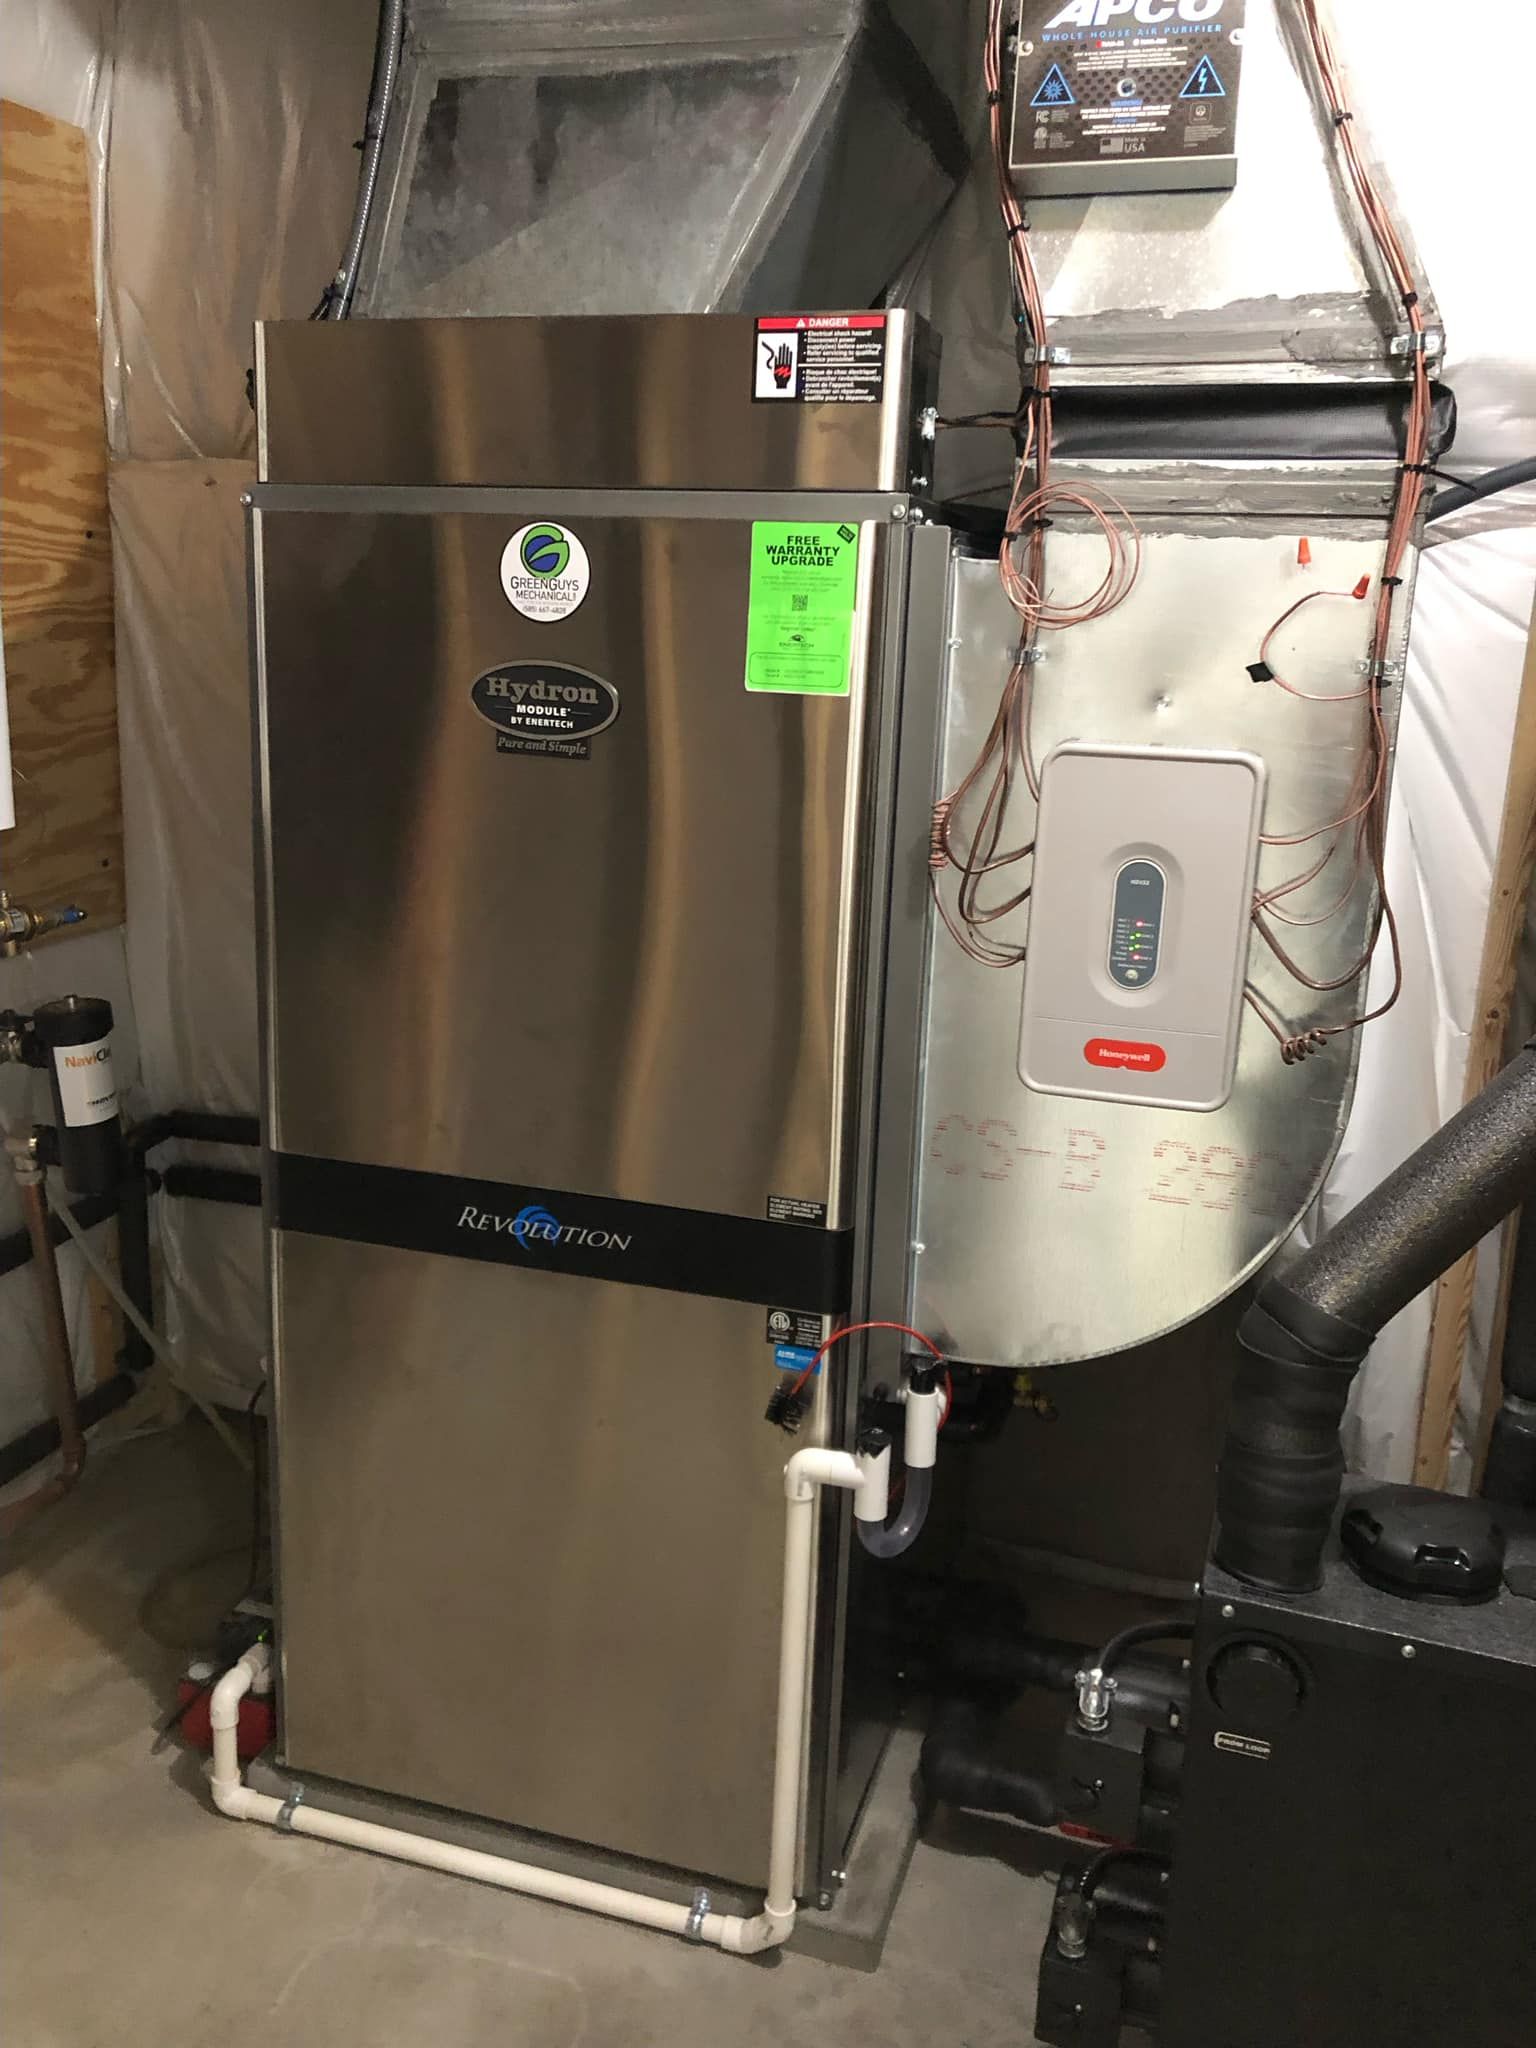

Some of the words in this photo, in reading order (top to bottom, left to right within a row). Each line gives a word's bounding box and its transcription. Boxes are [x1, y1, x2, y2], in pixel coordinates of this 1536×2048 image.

[1042, 31, 1083, 42] WHOLE
[1091, 28, 1130, 39] HOUSE
[1137, 27, 1158, 36] AIR
[1164, 24, 1223, 35] PURIFIER
[1124, 143, 1146, 153] USA
[808, 318, 849, 327] DANGER
[787, 535, 820, 546] FREE
[766, 545, 840, 557] WARRANTY
[771, 555, 834, 567] UPGRADE
[486, 677, 598, 704] Hydron
[511, 716, 522, 725] BY
[525, 717, 574, 729] ENERTECH
[498, 736, 523, 749] Pure
[525, 738, 547, 751] and
[548, 740, 587, 756] Simple
[1098, 1048, 1151, 1062] Honeywell
[457, 1206, 632, 1251] REVOLUTION
